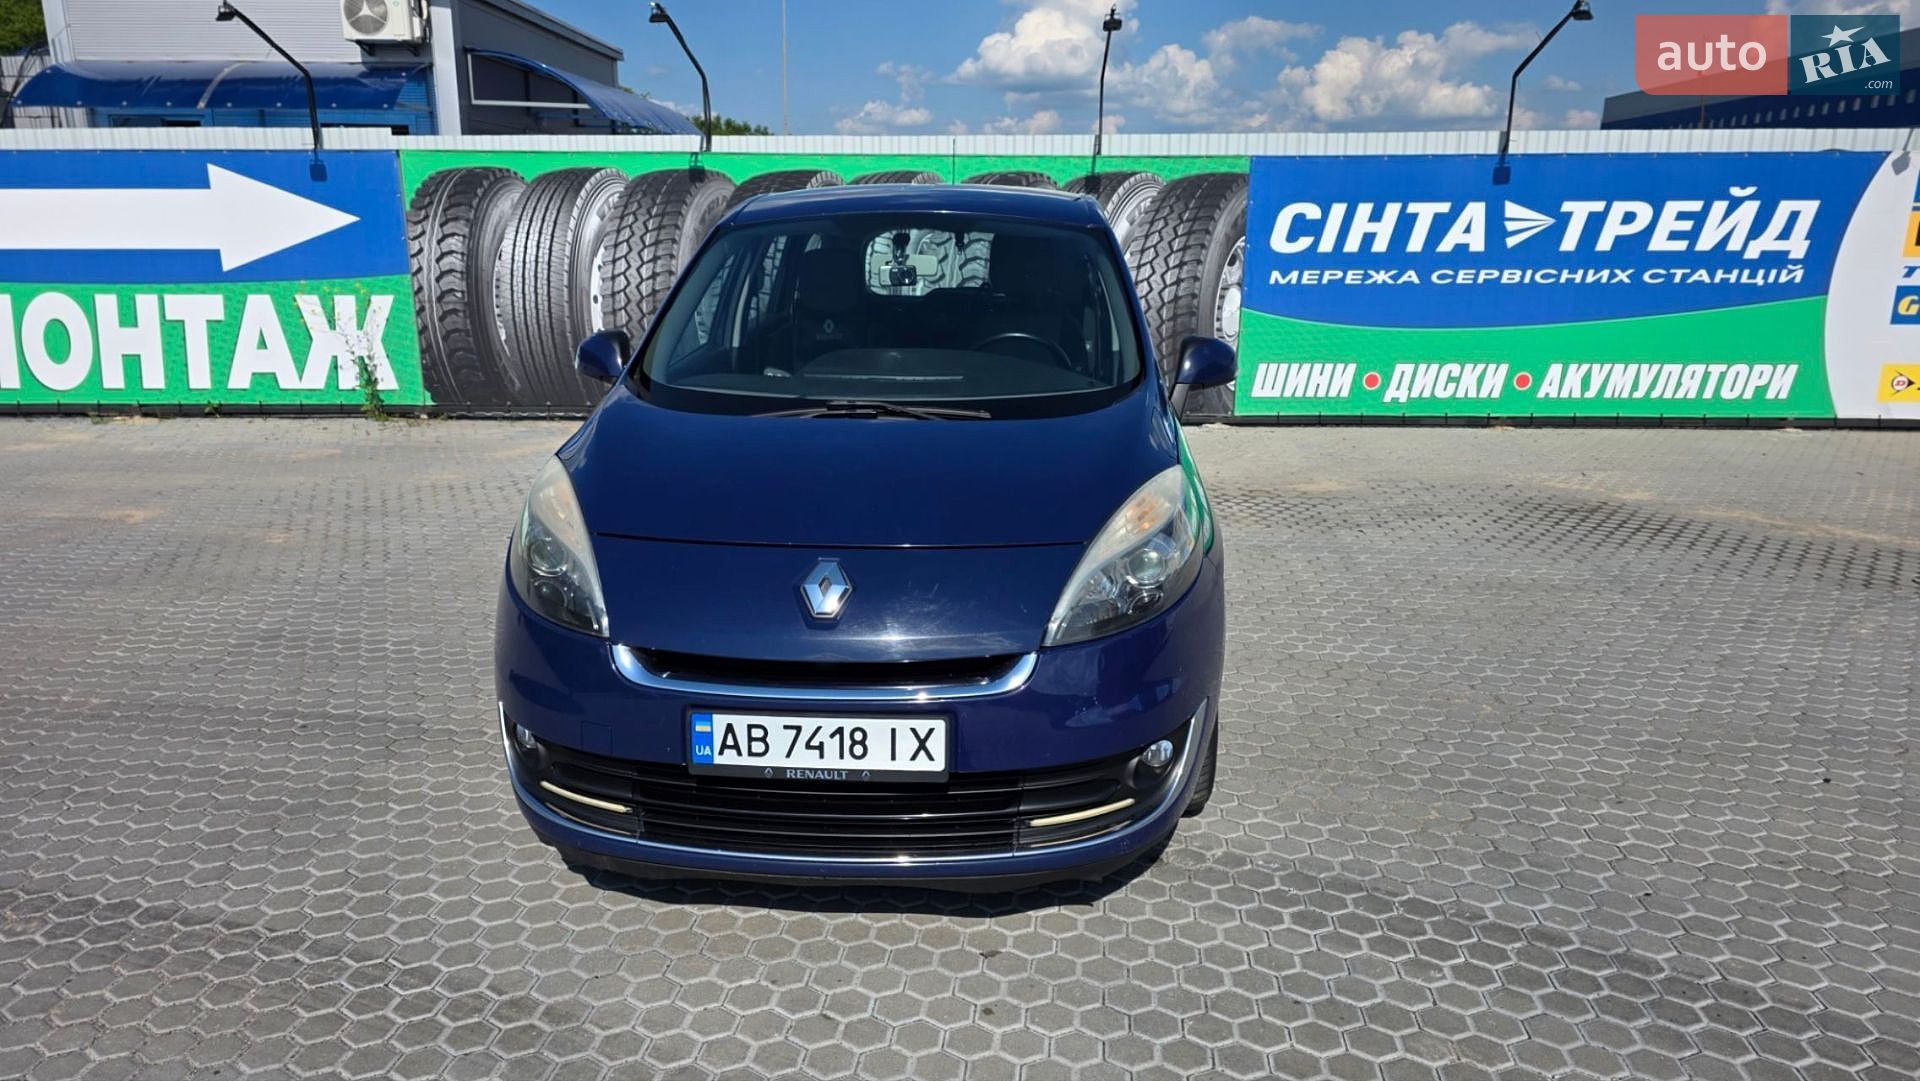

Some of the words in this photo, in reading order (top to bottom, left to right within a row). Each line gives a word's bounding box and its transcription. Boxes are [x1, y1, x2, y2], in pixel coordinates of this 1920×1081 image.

[1269, 202, 1486, 254] СІНТА
[1559, 186, 1821, 259] ТРЕЙД
[1269, 270, 1420, 284] МЕРЕЖА
[1431, 269, 1634, 284] СЕРВІСНИХ
[1643, 264, 1804, 286] СТАНЦІЙ
[1251, 363, 1357, 398] ШИНИ
[1383, 363, 1509, 402] ДИСКИ
[1536, 363, 1799, 400] АКУМУЛЯТОРИ
[695, 745, 712, 756] UA
[718, 722, 770, 758] AB
[783, 725, 869, 760] 7418
[890, 727, 936, 762] IX
[786, 769, 849, 781] RENAULT
